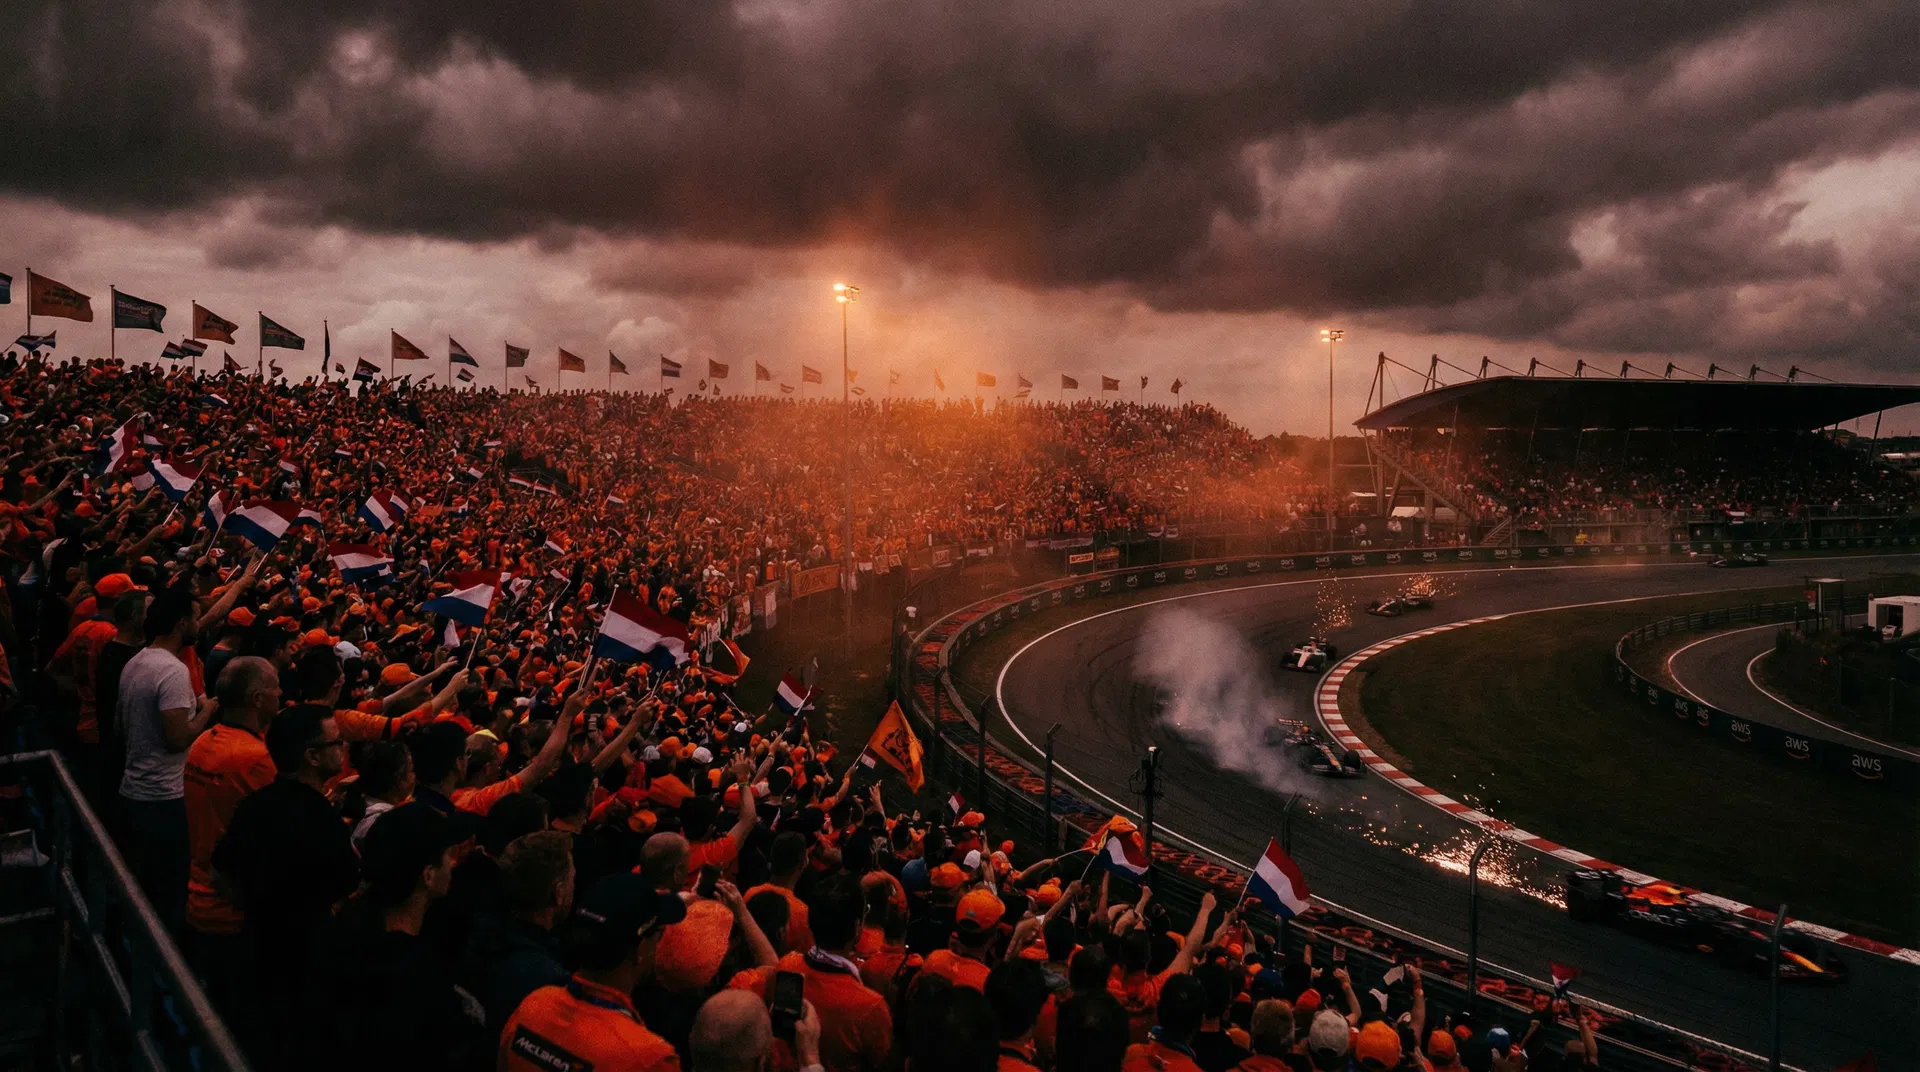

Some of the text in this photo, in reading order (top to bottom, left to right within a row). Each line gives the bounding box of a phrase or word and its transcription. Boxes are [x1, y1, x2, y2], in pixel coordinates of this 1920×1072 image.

[1731, 719, 1751, 735] aws
[1785, 735, 1810, 752] aws
[1852, 754, 1883, 772] aws
[514, 1036, 571, 1072] McLaren
